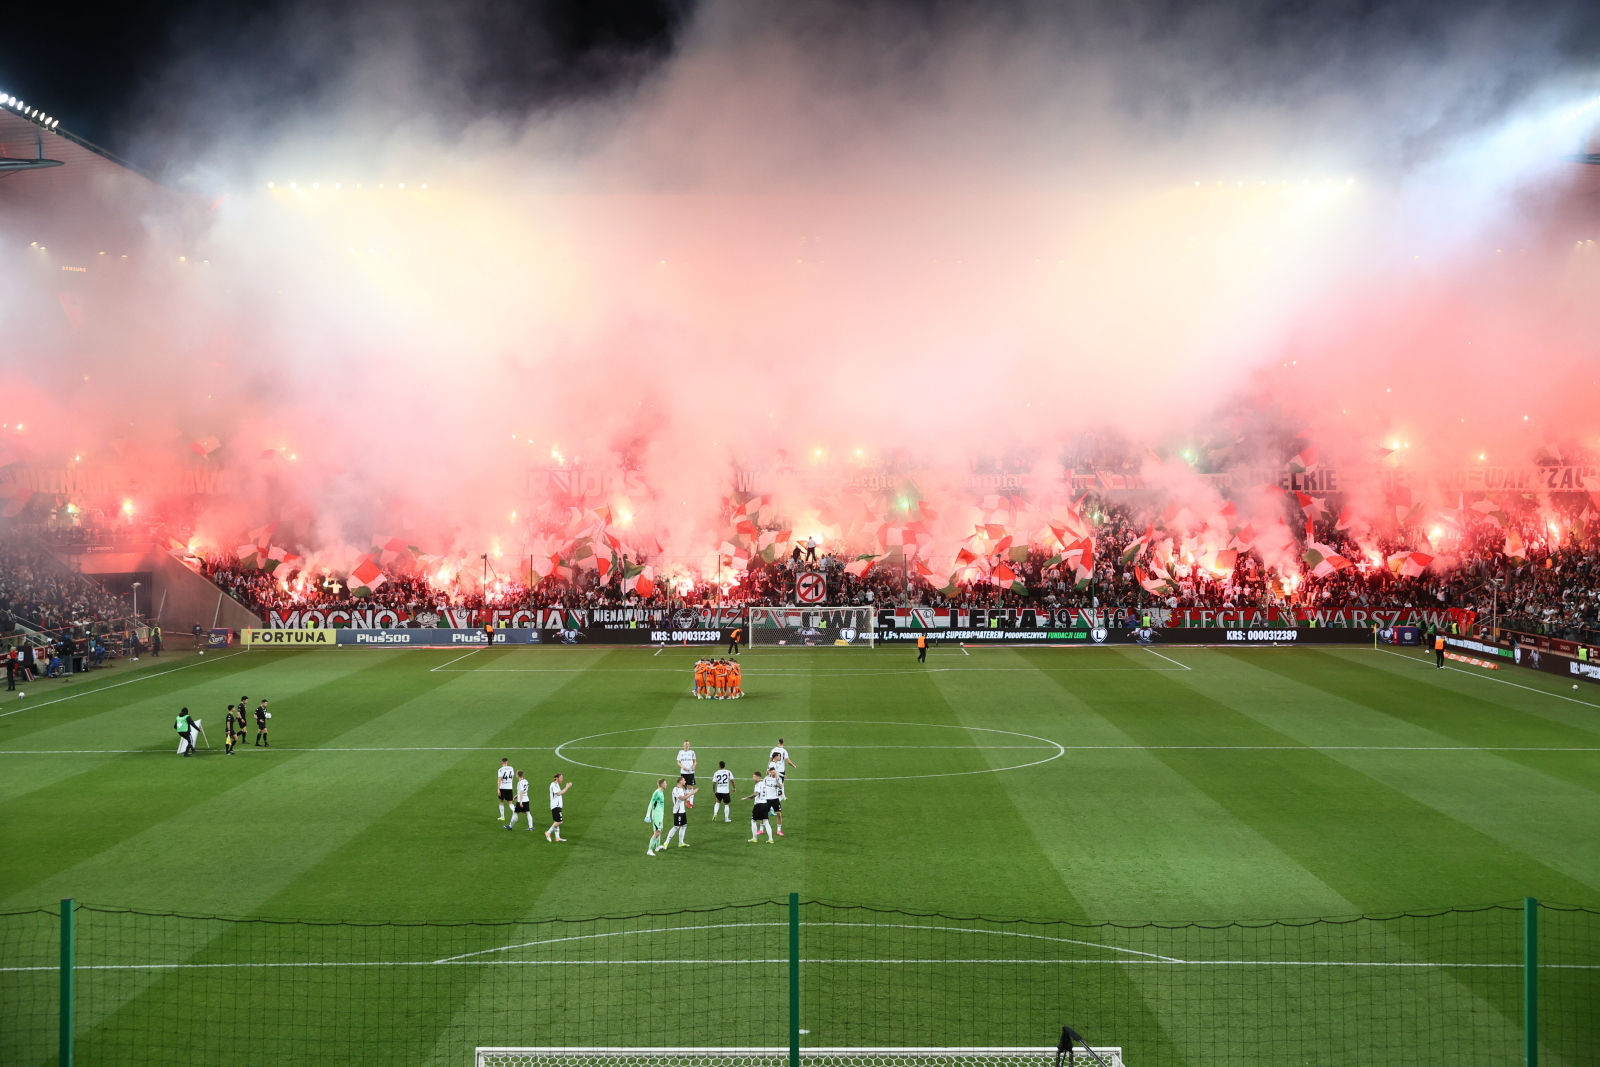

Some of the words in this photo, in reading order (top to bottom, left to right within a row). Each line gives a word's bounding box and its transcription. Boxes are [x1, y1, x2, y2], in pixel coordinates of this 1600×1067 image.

[61, 265, 87, 273] SAMSUNG
[251, 632, 326, 643] FORTUNA
[356, 632, 411, 643] Plus500
[651, 631, 670, 642] KRS:
[672, 631, 721, 642] 0000312389
[883, 631, 898, 641] 1,5%
[945, 630, 1005, 640] SUPERBOHATEREM
[1004, 632, 1048, 640] PODOPIECZNYCH
[1047, 632, 1073, 640] FUNDACJI
[1073, 632, 1088, 640] LEGII
[1226, 630, 1246, 641] KRS:
[1247, 630, 1298, 641] 0000312389
[502, 771, 513, 781] 44
[716, 773, 729, 785] 22
